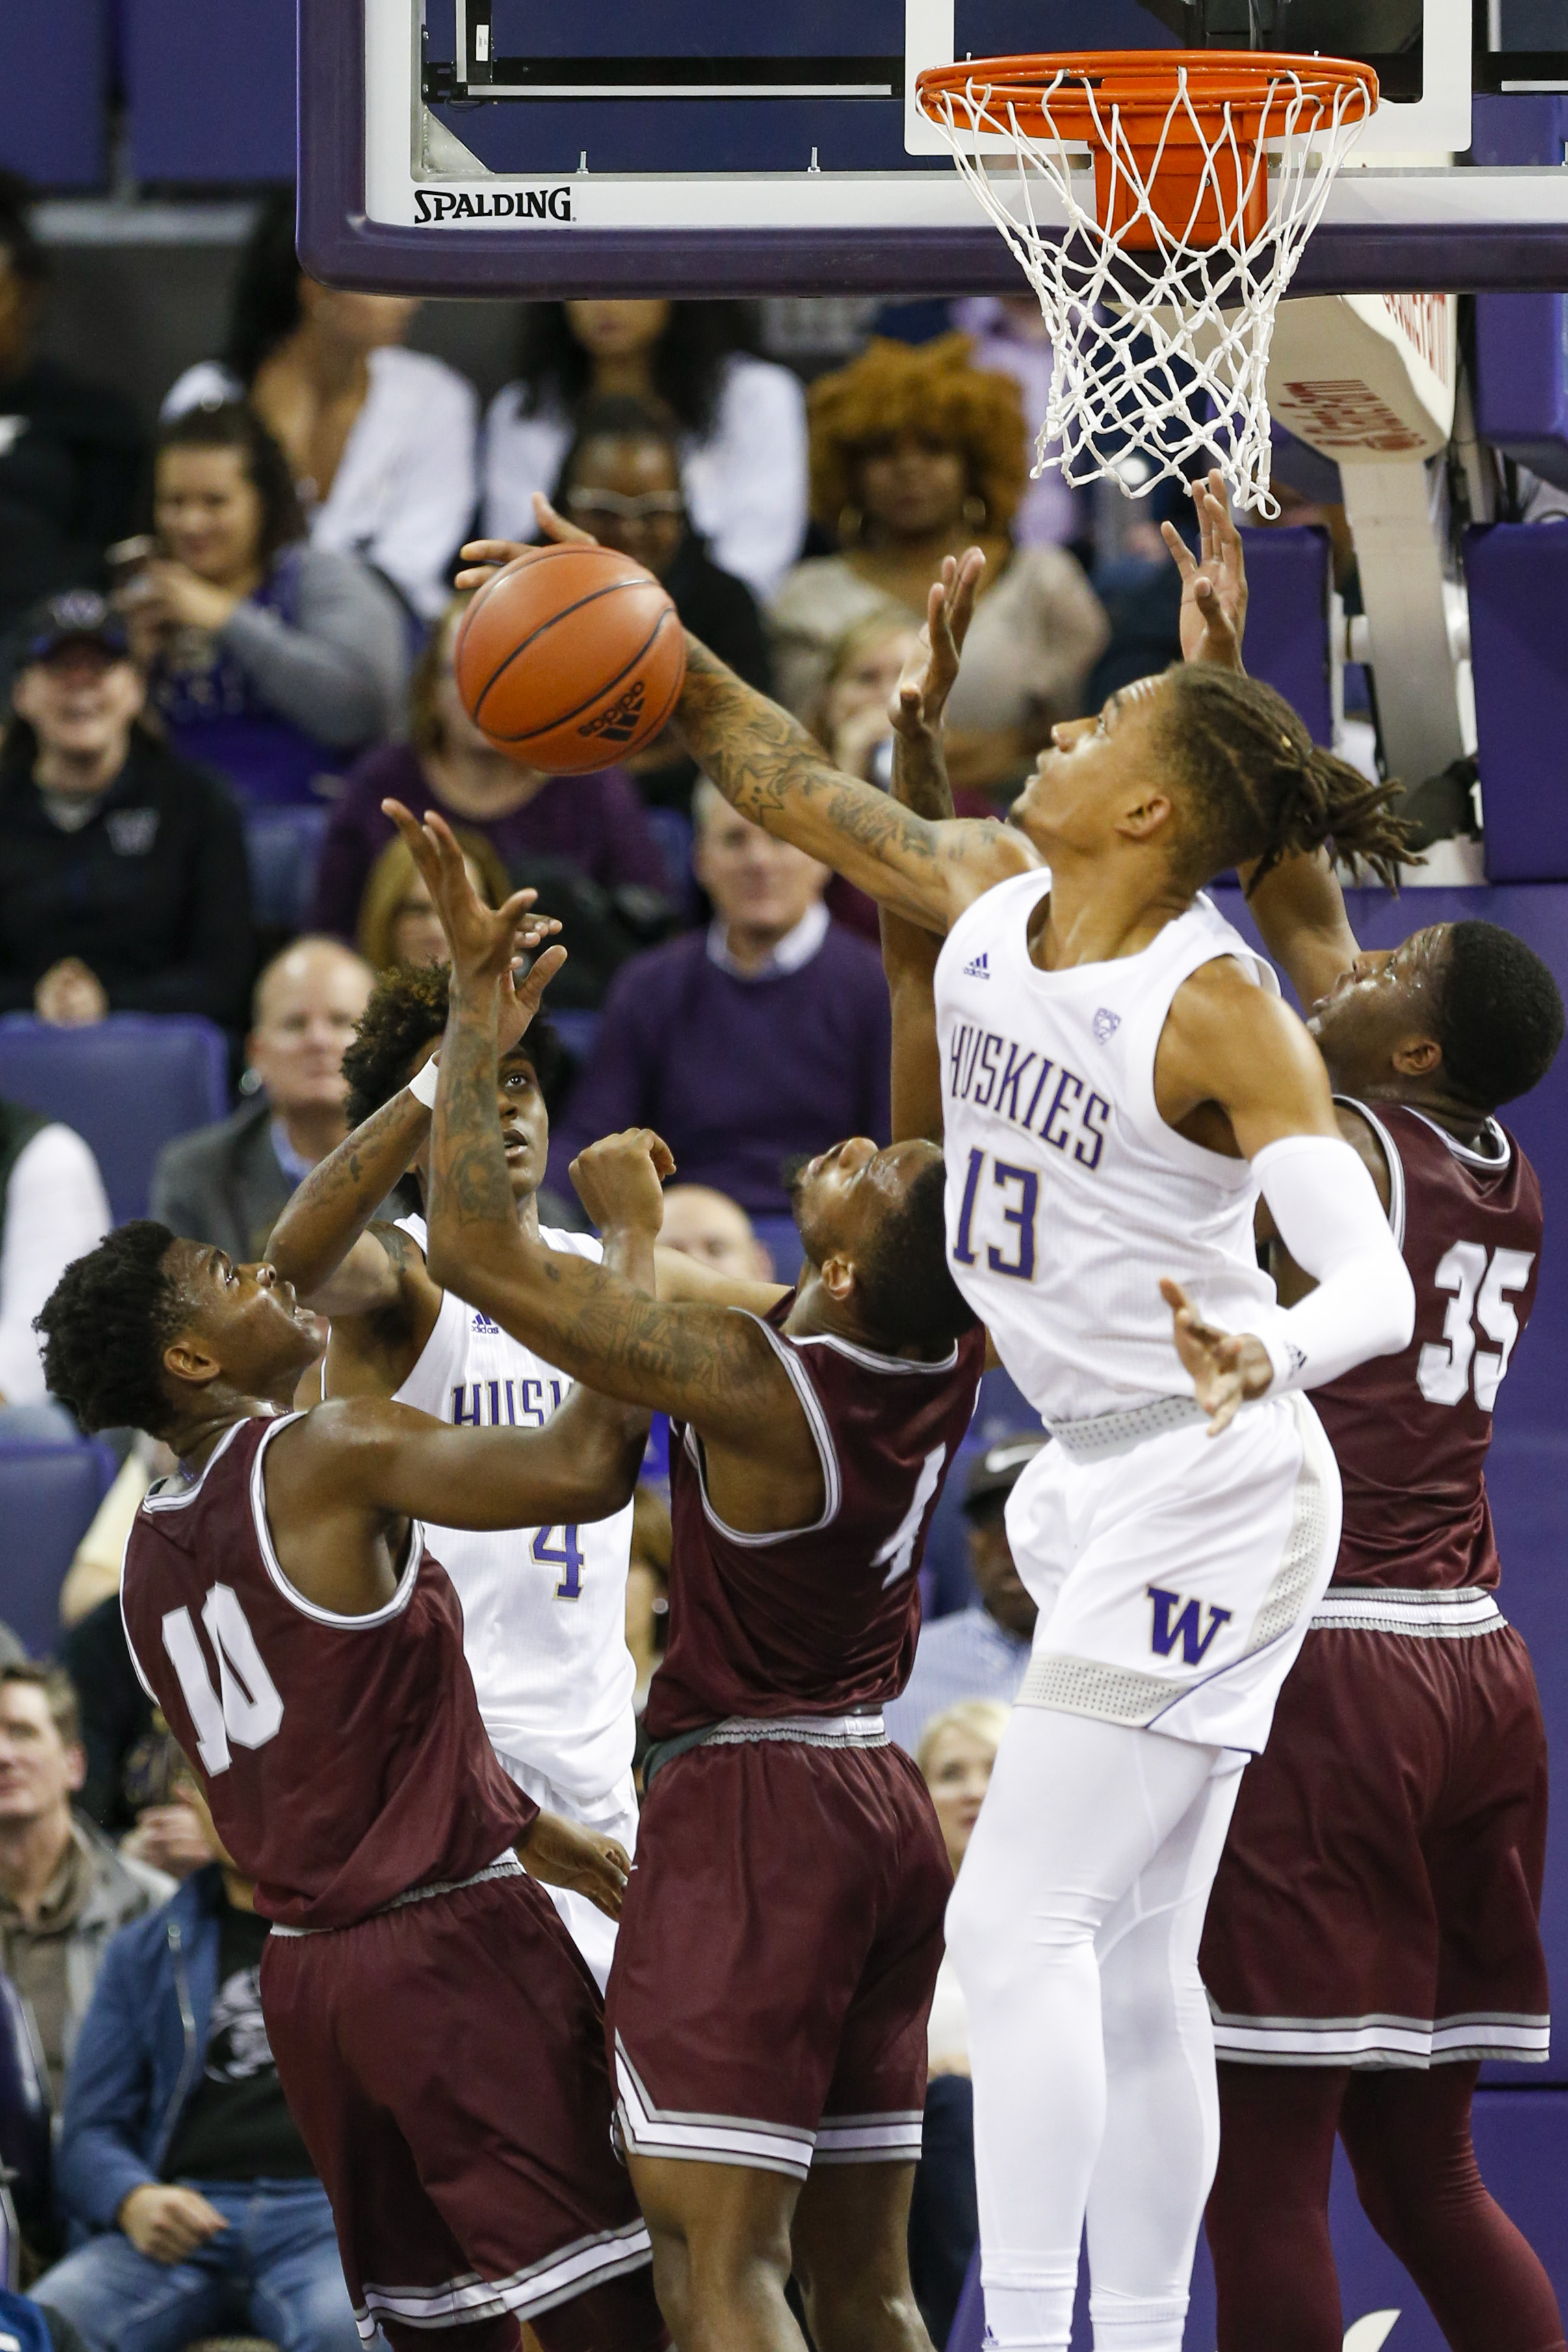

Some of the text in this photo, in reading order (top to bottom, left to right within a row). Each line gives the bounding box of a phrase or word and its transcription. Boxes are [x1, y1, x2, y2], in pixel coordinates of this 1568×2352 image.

[414, 187, 571, 224] SPALDING
[578, 681, 645, 737] adidas
[950, 1022, 1112, 1171] HUSKIES
[952, 1144, 1039, 1283] 13
[1415, 1239, 1536, 1413] 35
[529, 1524, 585, 1602] 4
[162, 1581, 285, 1778] 10
[1145, 1584, 1233, 1667] W
